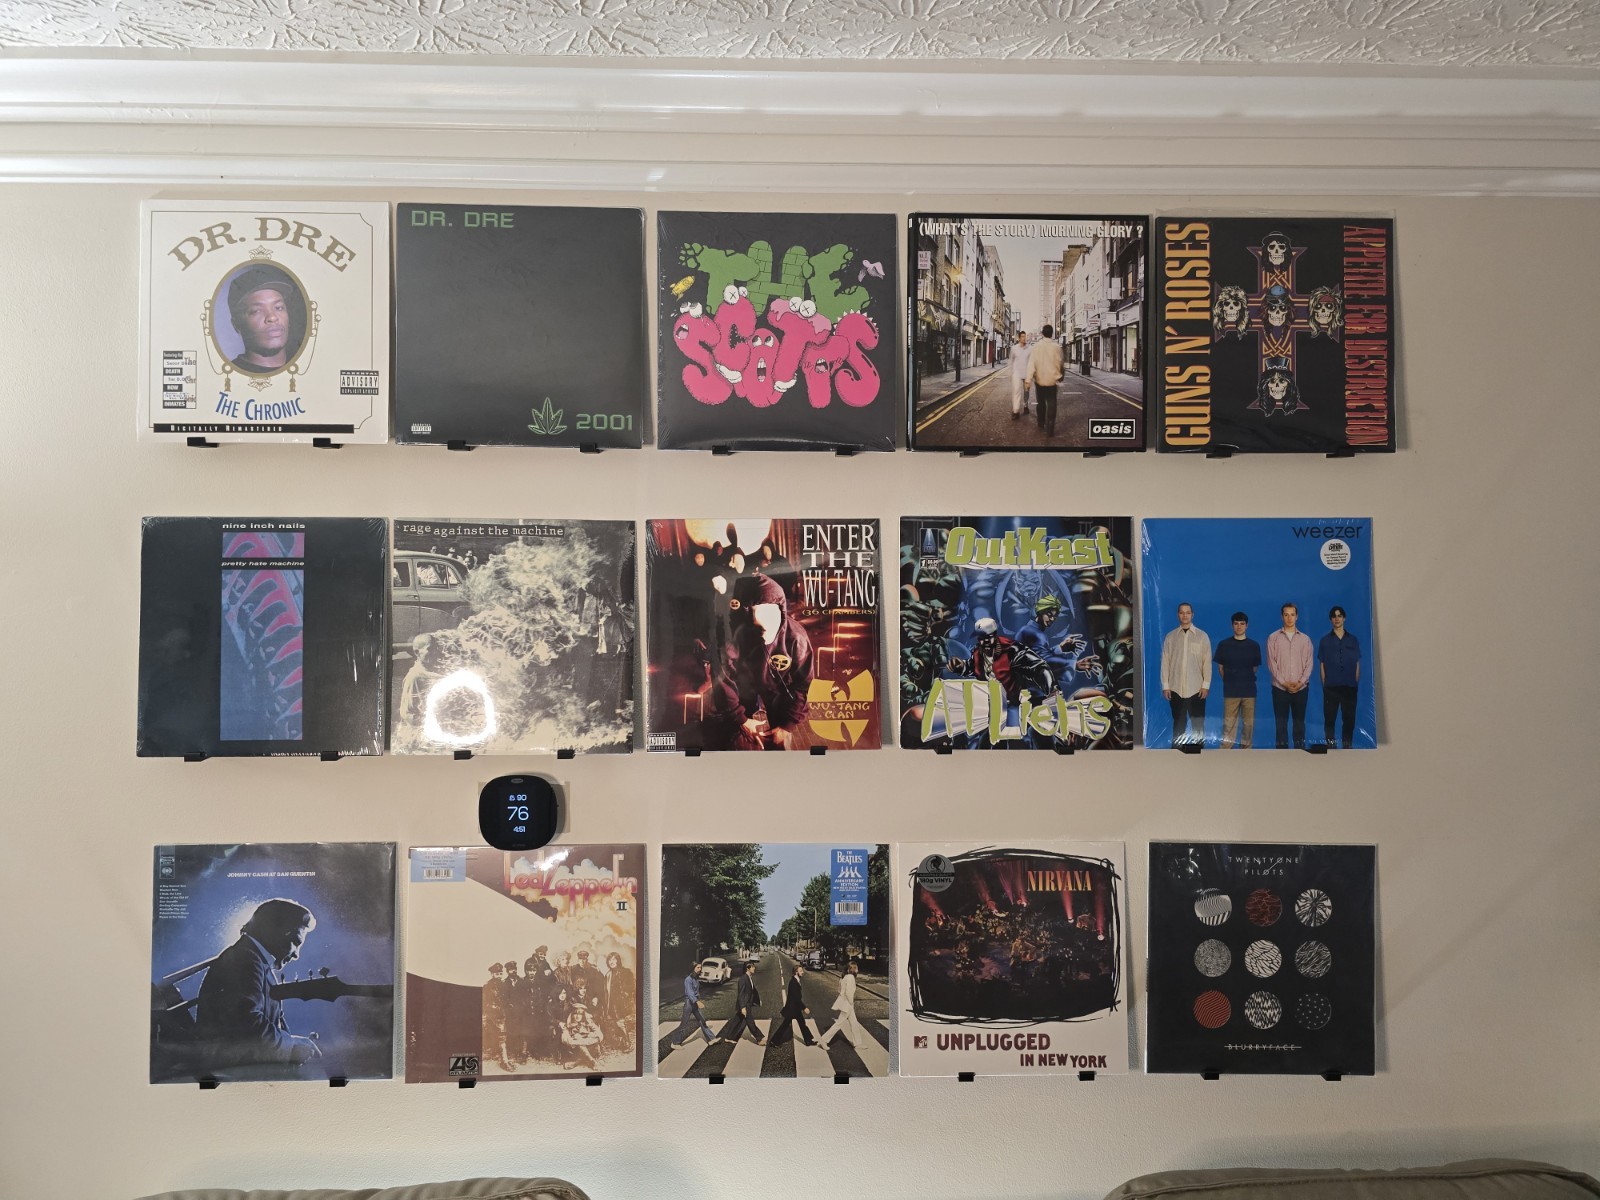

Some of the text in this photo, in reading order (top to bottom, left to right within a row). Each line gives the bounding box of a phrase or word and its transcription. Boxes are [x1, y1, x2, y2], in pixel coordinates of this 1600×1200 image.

[411, 210, 514, 229] DR. DRE
[918, 222, 1144, 239] (WHAT'S THE STORY) MORNING GLORY ?
[168, 217, 357, 272] DR. DRE
[1165, 222, 1211, 321] ROSES
[680, 240, 871, 324] THE
[1343, 225, 1389, 446] APPETITE FOR DESTRUCTION
[673, 296, 881, 409] SCOTTS
[341, 376, 378, 387] ADVISORY
[1165, 365, 1211, 446] GUNS
[170, 424, 283, 433] DIGITALLY REMASTERED
[575, 413, 633, 431] 2001
[1092, 422, 1132, 435] oasis
[402, 523, 564, 538] rage against the machine
[802, 524, 876, 550] ENTER
[1291, 526, 1363, 539] weezer
[944, 526, 1114, 570] OutKast
[802, 551, 874, 568] THE
[802, 569, 876, 608] WU-TANG
[801, 608, 820, 617] (36
[808, 702, 870, 711] WU-TANG
[824, 710, 854, 719] CLAN
[507, 806, 529, 821] 76
[836, 850, 863, 865] BEATLES
[1026, 870, 1092, 892] NIRVANA
[616, 901, 628, 911] II
[936, 1033, 1051, 1051] UNPLUGGED
[1020, 1053, 1107, 1068] IN NEW YORK
